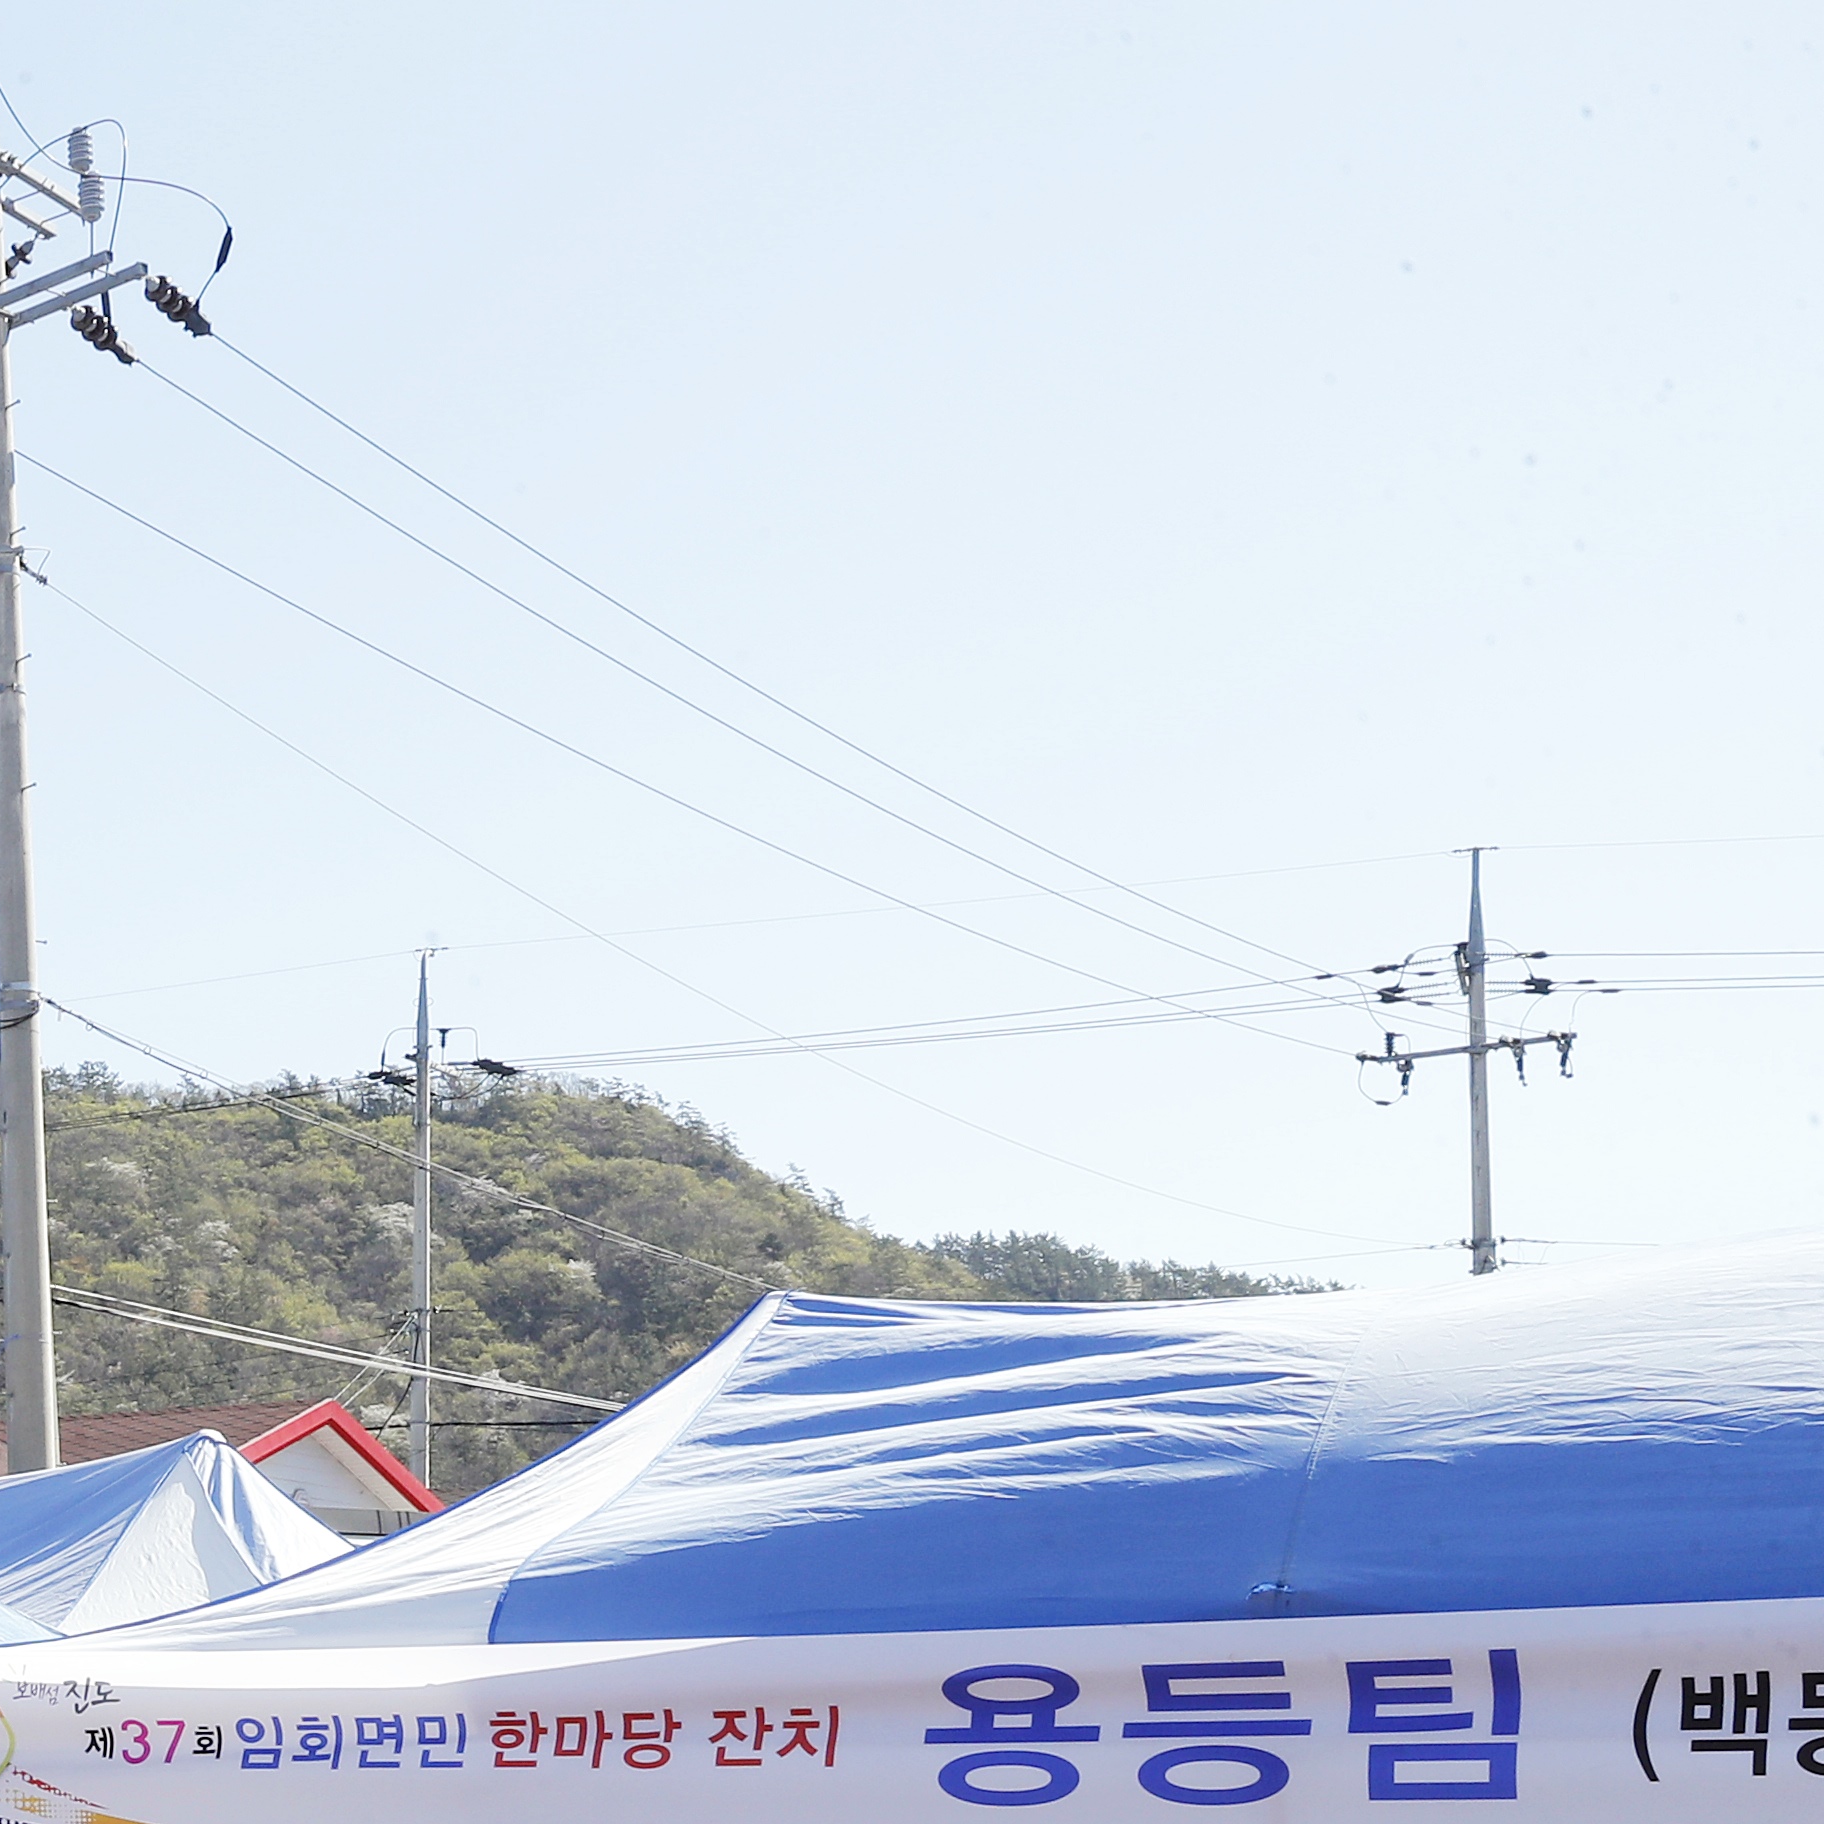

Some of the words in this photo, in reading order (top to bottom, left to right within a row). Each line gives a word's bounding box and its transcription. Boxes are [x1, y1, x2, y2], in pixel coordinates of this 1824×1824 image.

[63, 1677, 121, 1714] 진도
[924, 1648, 1522, 1806] 용등팀
[84, 1718, 224, 1764] 제37회
[234, 1713, 467, 1771] 임회면민
[488, 1709, 682, 1770] 한마당
[707, 1705, 841, 1768] 잔치
